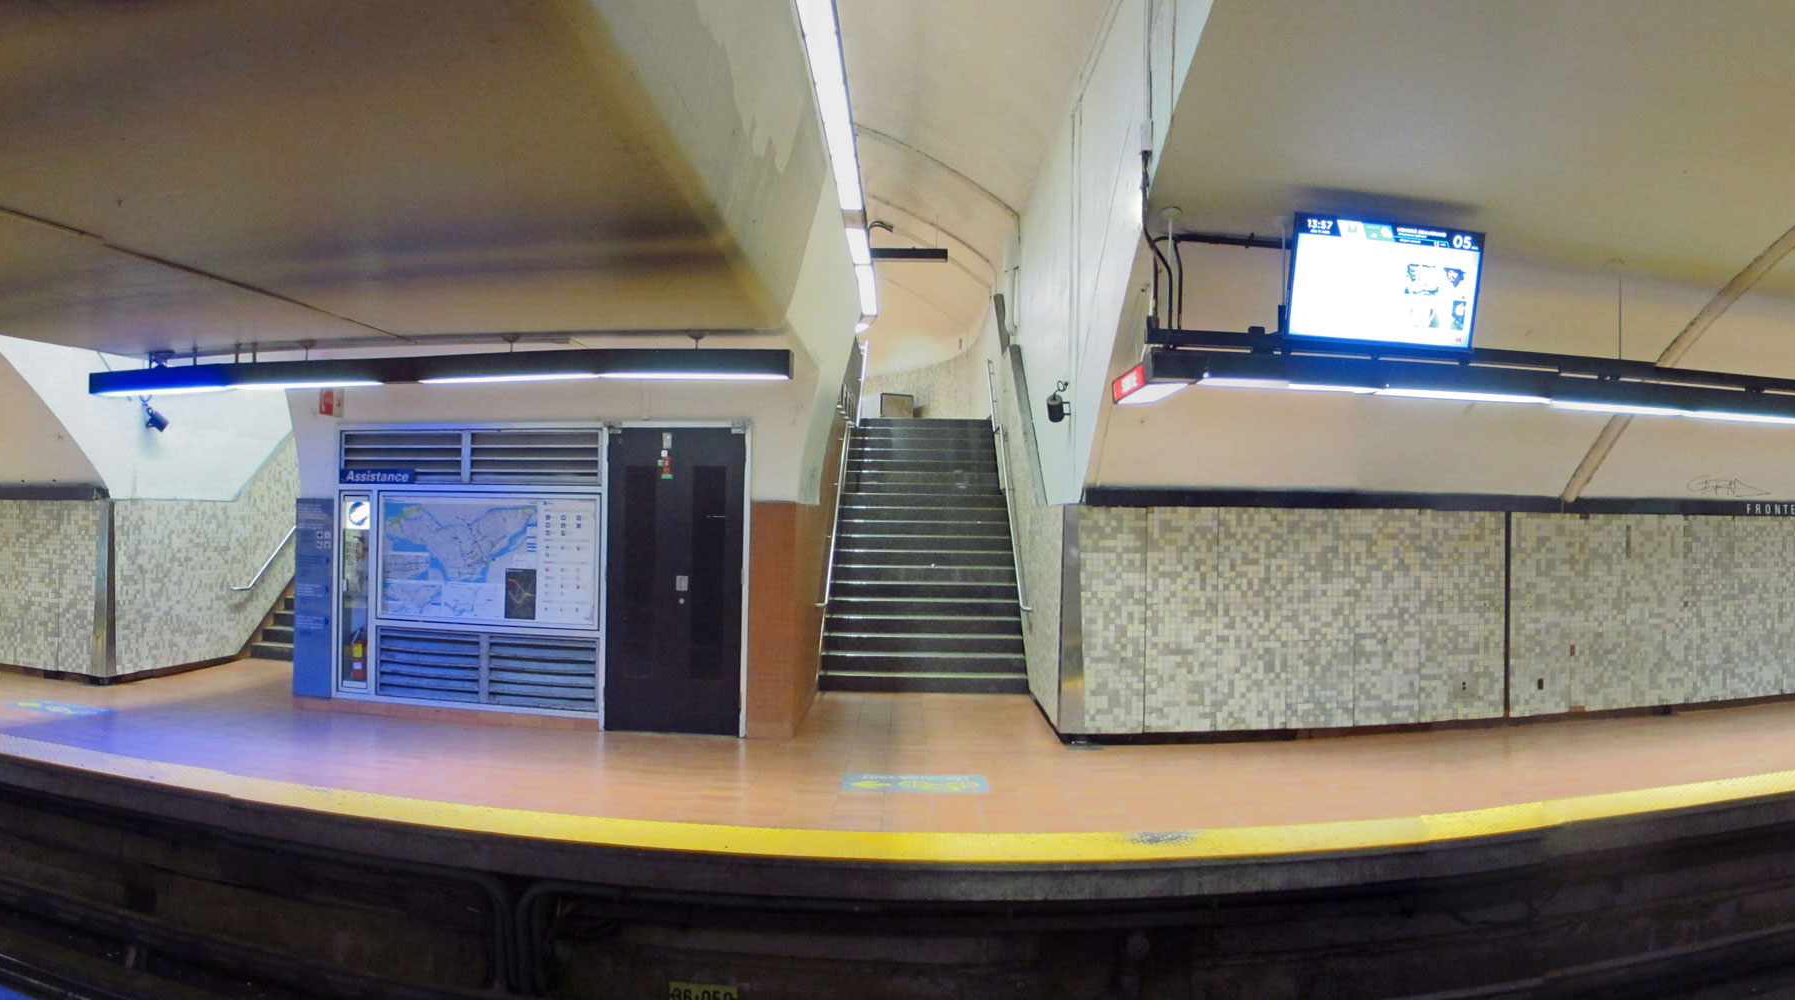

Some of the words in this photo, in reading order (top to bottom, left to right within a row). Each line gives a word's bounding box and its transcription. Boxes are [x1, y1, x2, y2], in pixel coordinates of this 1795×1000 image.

[1307, 219, 1333, 230] 13:57
[1452, 235, 1472, 250] 05
[346, 470, 409, 482] Assistance
